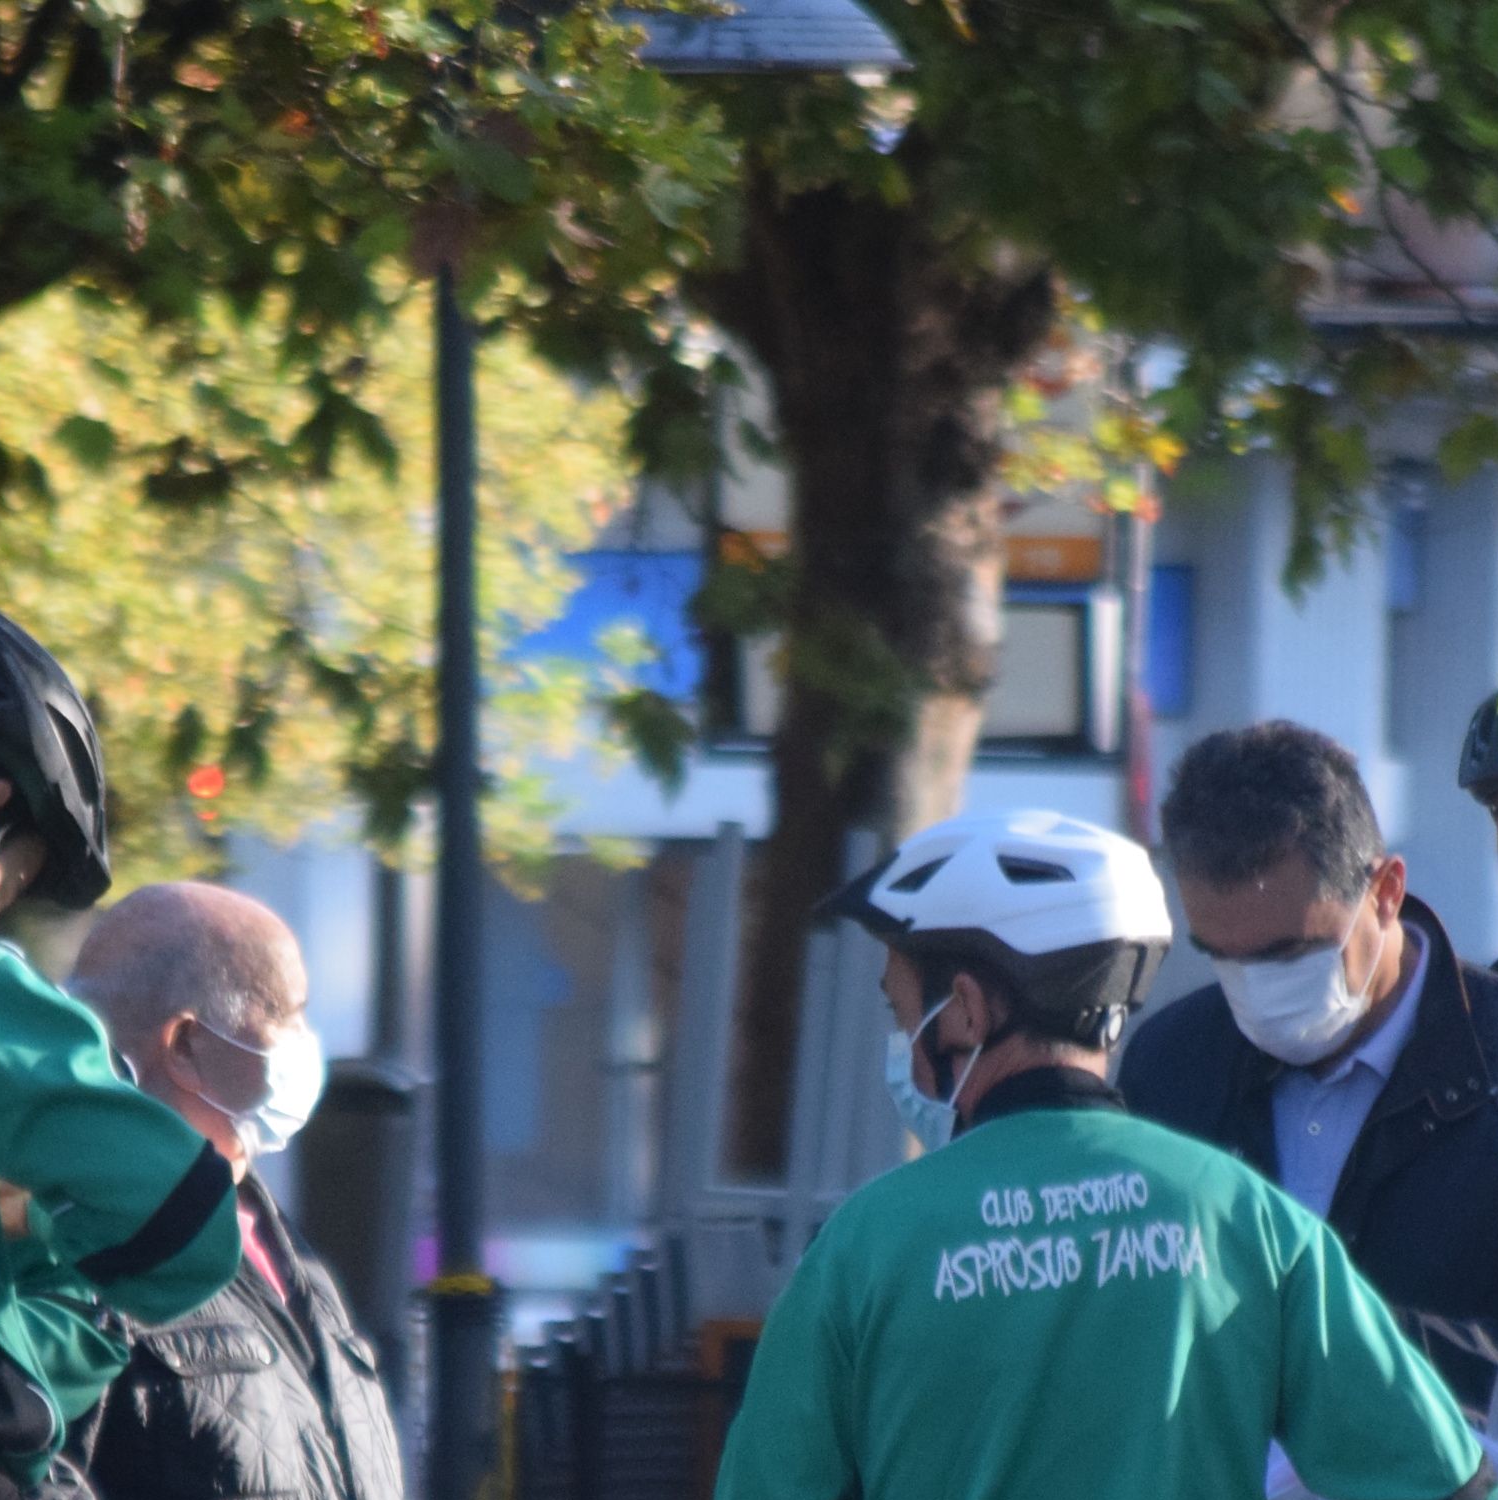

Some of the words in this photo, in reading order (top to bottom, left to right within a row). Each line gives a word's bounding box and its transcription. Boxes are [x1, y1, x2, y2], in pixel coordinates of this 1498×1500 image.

[980, 1186, 1034, 1227] CLUB
[1040, 1172, 1149, 1225] DEPORTIVO
[934, 1236, 1082, 1301] ASPROSUB
[1091, 1221, 1208, 1288] ZAMORA
